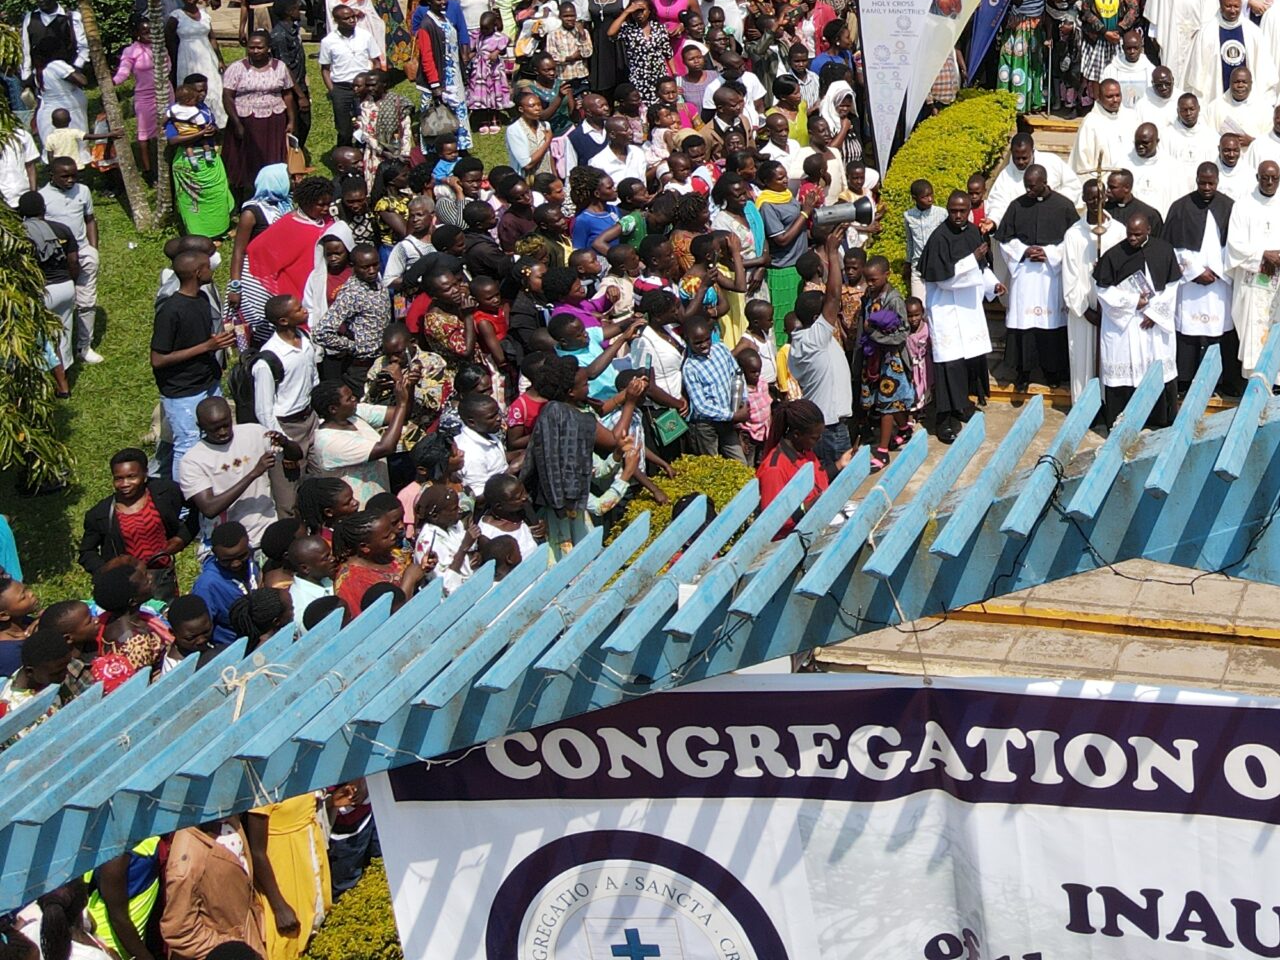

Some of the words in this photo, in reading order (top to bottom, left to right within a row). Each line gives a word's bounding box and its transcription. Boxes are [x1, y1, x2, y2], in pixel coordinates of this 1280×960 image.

[485, 720, 1198, 793] CONGREGATION
[606, 876, 618, 890] A
[634, 876, 713, 928] SANCTA
